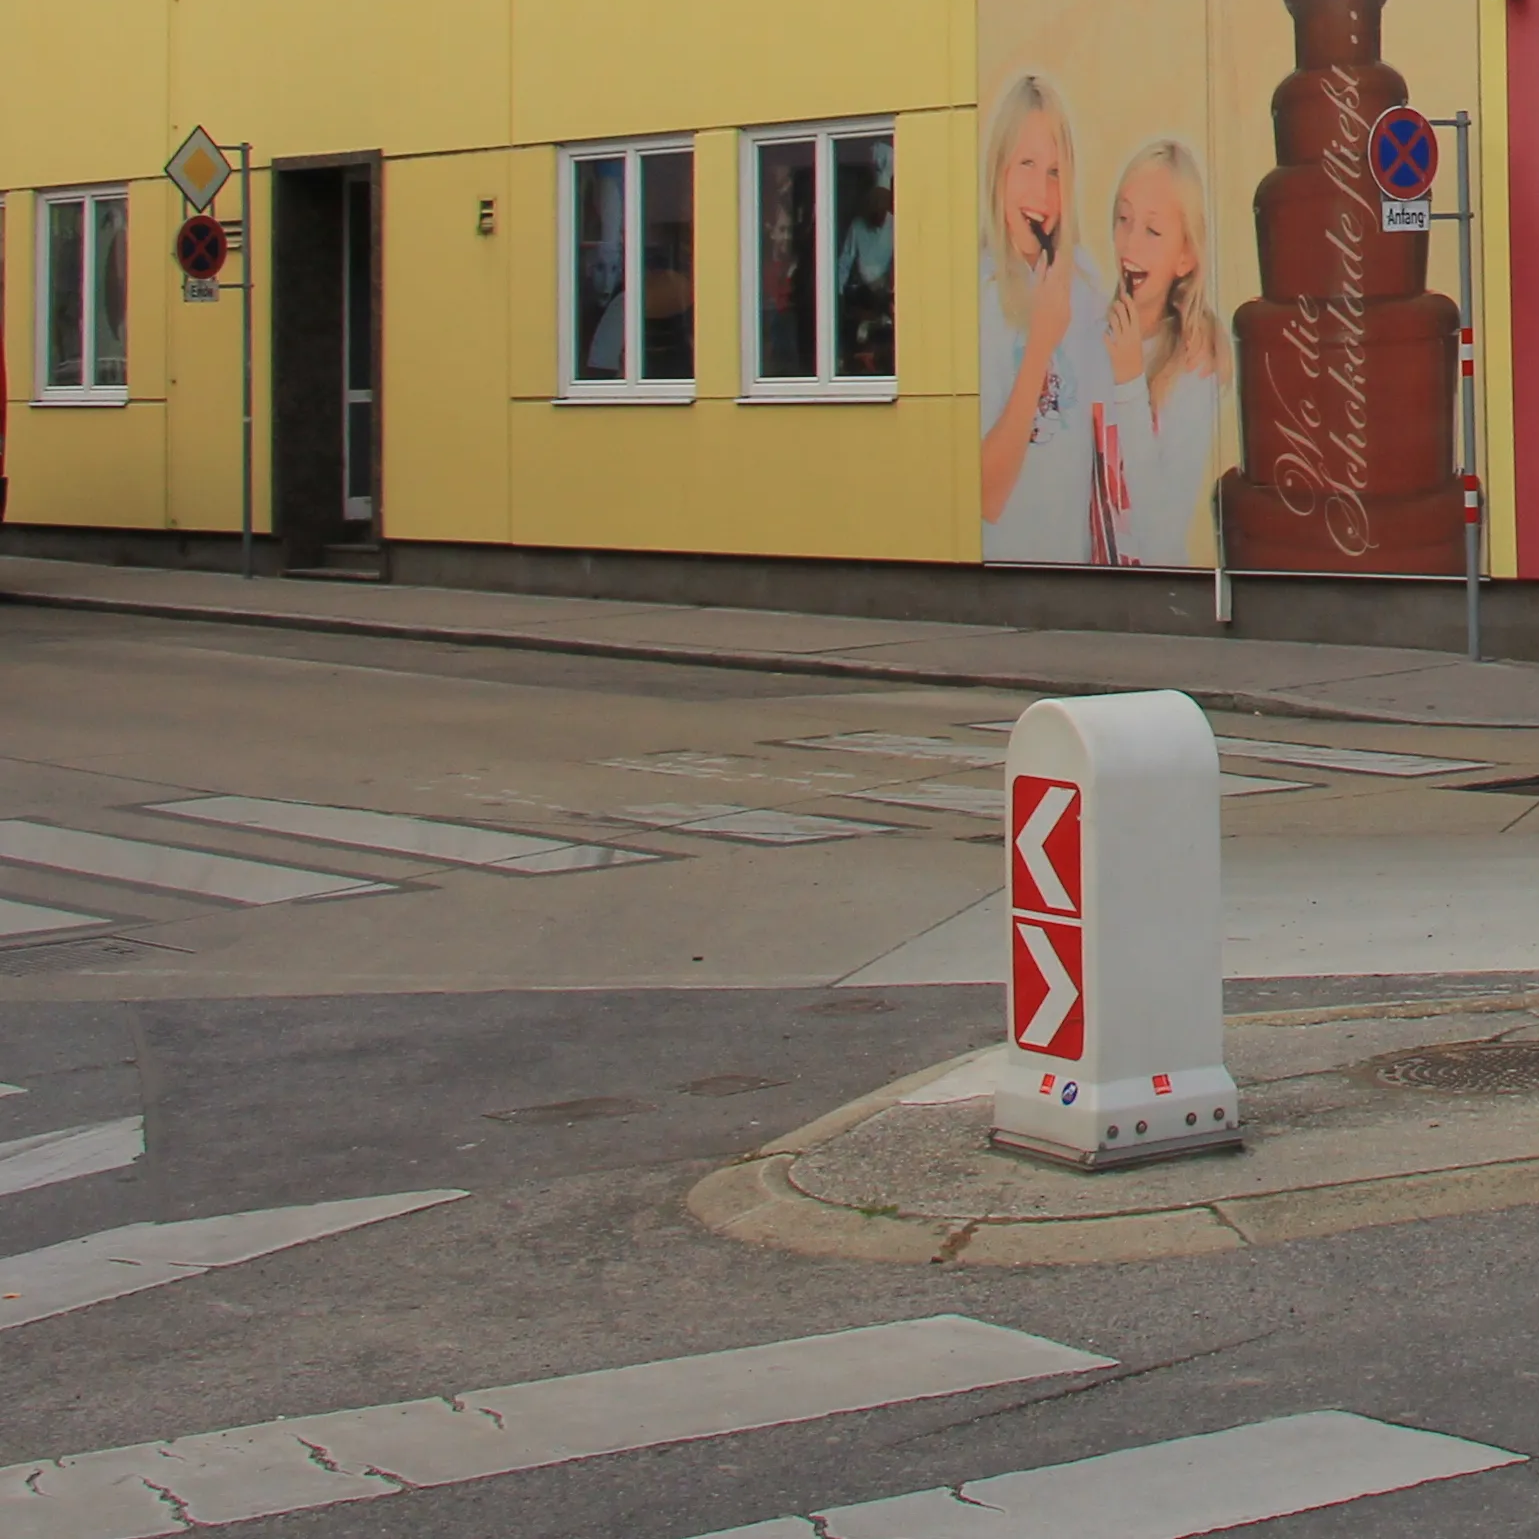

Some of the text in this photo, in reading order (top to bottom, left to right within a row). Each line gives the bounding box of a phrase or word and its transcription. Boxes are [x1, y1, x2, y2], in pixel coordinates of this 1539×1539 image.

[1387, 207, 1424, 229] Anfang
[1265, 294, 1324, 516] Wo die
[1321, 214, 1379, 557] Schokolade
